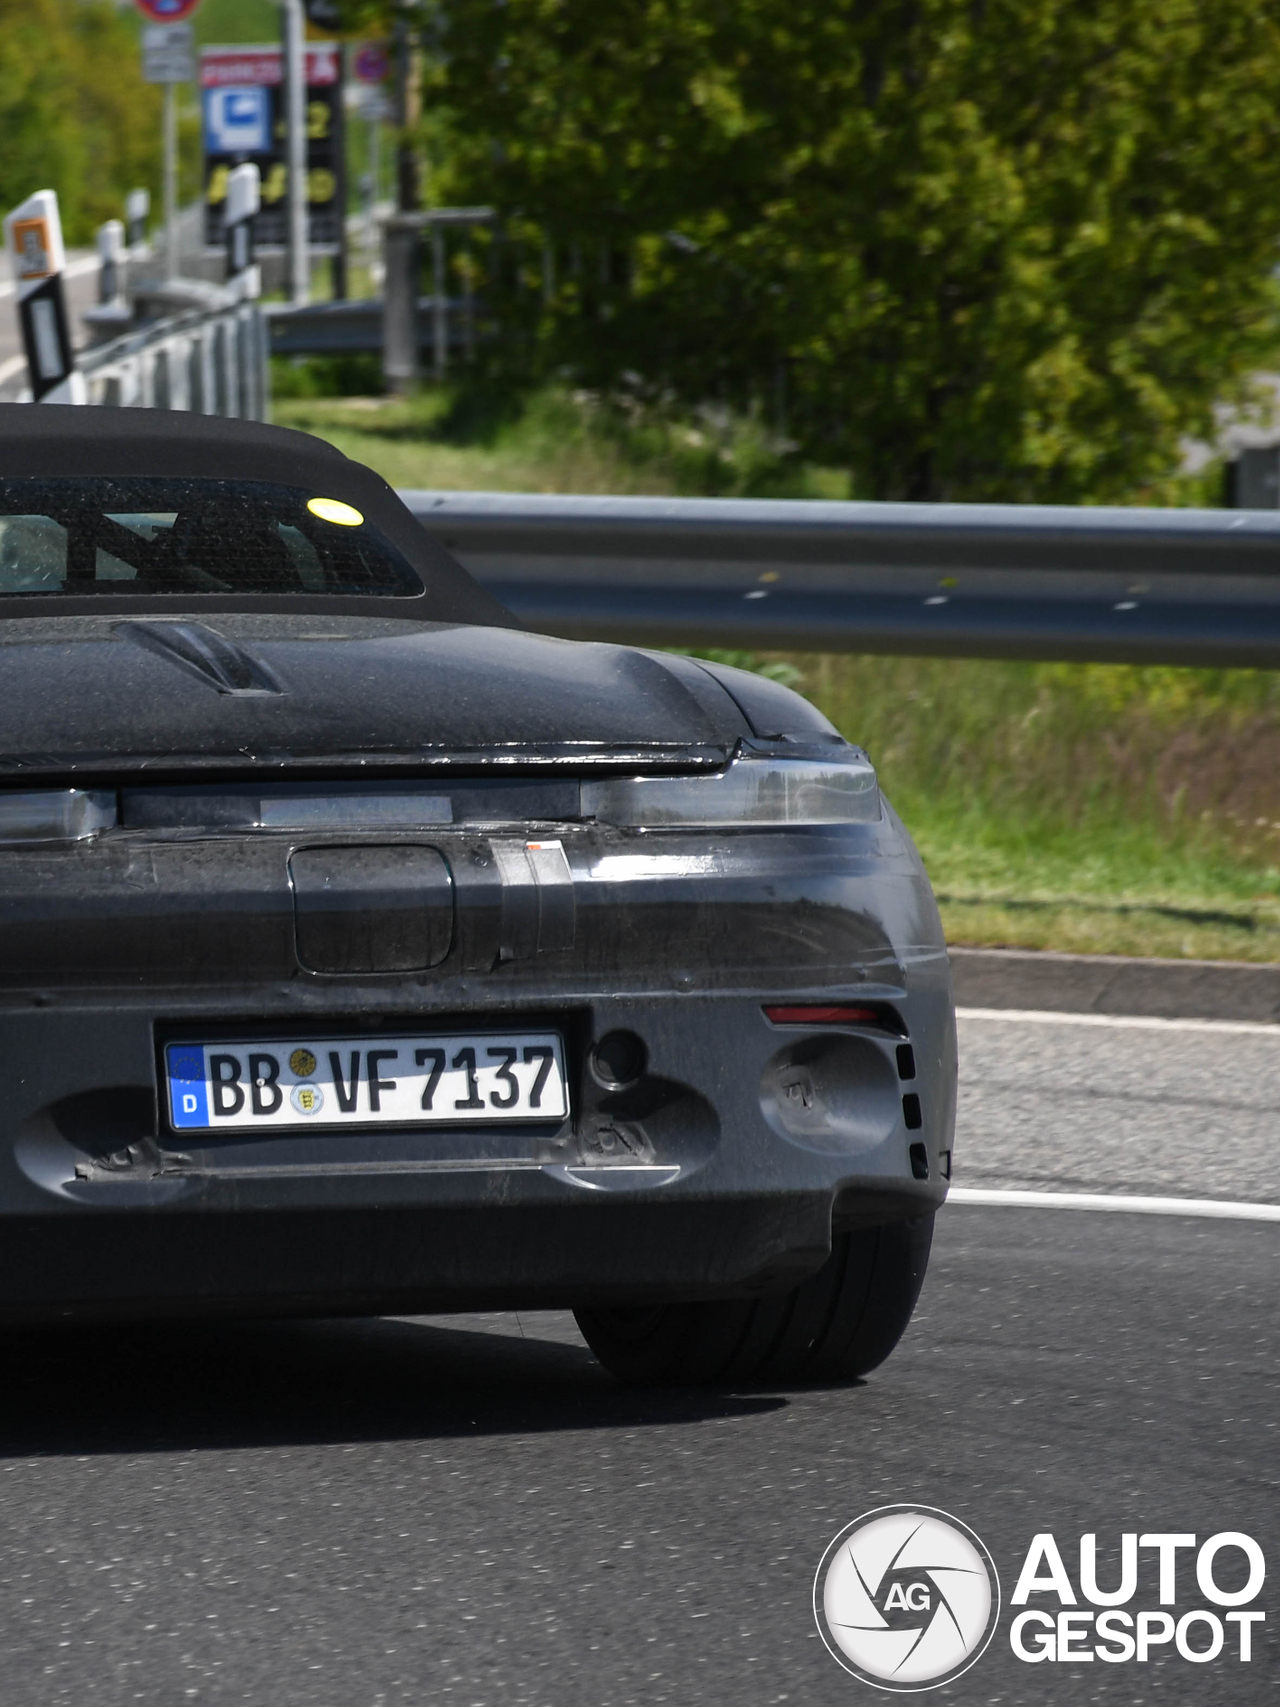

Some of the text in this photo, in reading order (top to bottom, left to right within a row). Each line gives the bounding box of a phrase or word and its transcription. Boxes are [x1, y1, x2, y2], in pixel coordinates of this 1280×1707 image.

[182, 1094, 198, 1114] D
[209, 1054, 284, 1117] BB
[328, 1049, 400, 1113] VF
[414, 1046, 554, 1110] 7137
